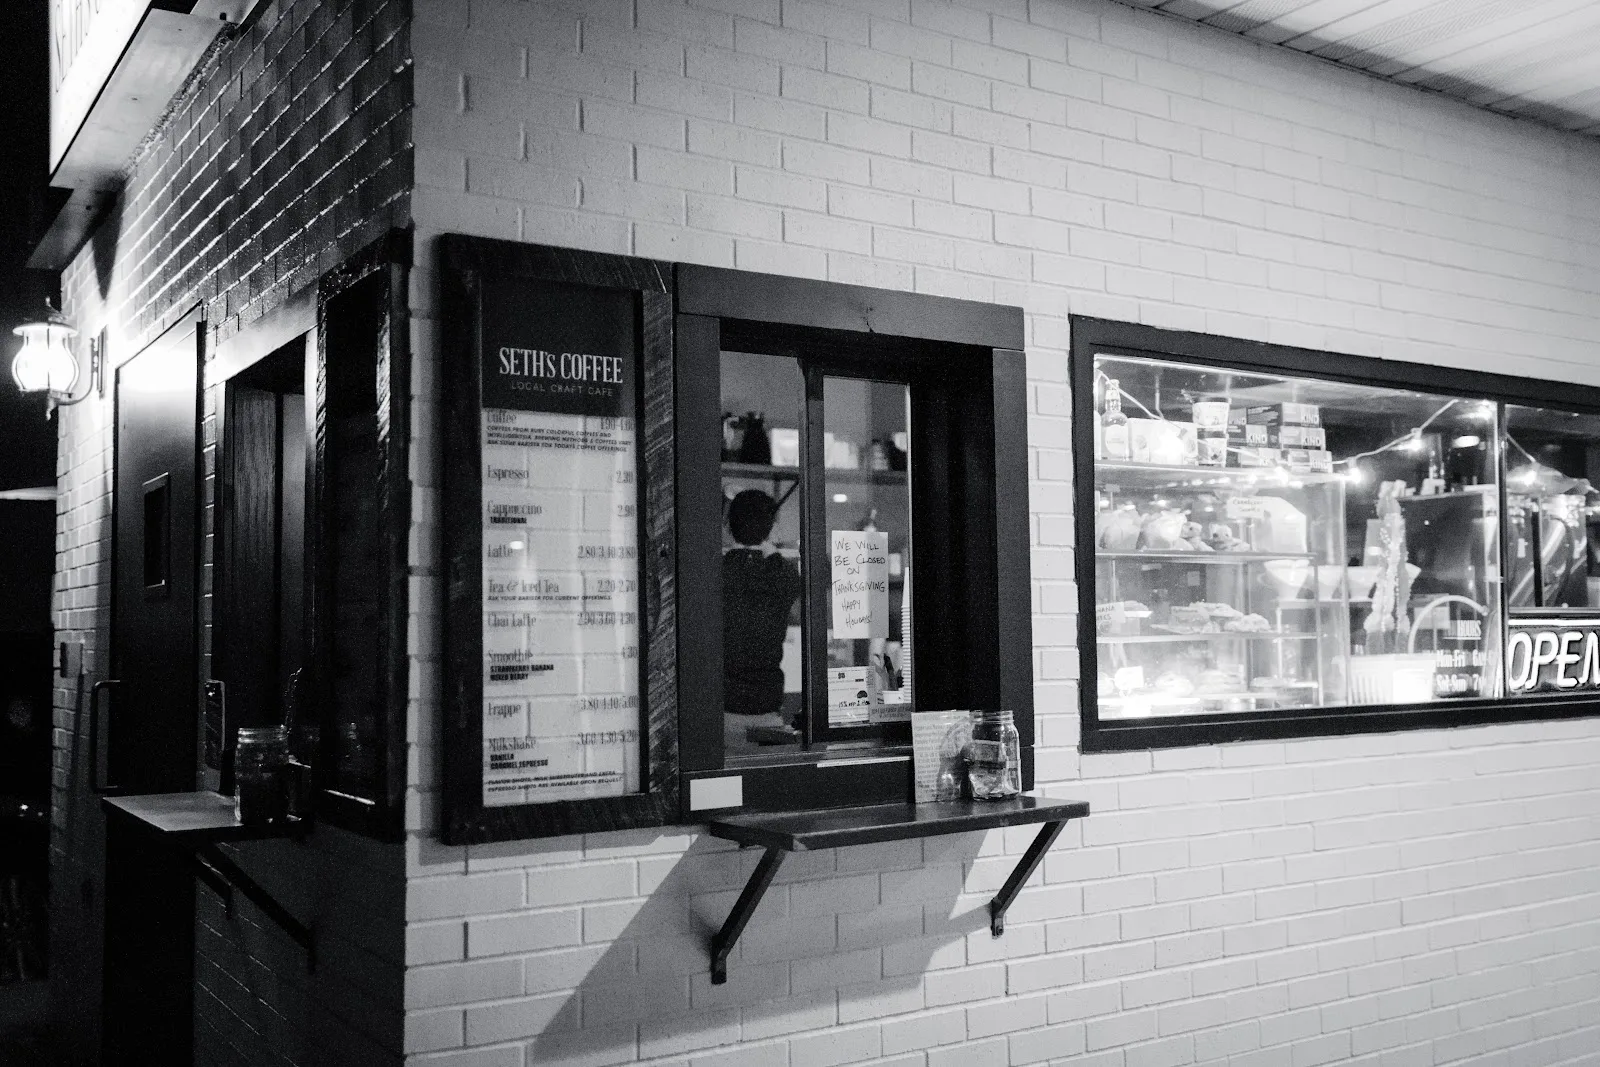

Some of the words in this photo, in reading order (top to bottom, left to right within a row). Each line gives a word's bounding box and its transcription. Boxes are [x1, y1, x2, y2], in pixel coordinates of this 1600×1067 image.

[560, 352, 623, 384] COFFEE
[511, 381, 545, 392] LOCAL
[551, 383, 582, 394] CRAFT
[488, 465, 530, 480] Espresso
[488, 500, 542, 517] Cappuccino
[488, 544, 514, 558] Latte
[835, 538, 851, 551] WE
[856, 540, 880, 551] WILL
[834, 556, 850, 566] BE
[856, 554, 886, 564] CLOSED
[846, 566, 860, 575] ON
[488, 579, 504, 592] Tea
[522, 580, 541, 592] Iced
[544, 579, 560, 592] Tea
[832, 579, 886, 596] THANKSGIVING
[842, 598, 860, 612] HAPPY
[488, 612, 509, 627] Chai
[512, 613, 536, 628] Latte
[488, 702, 522, 718] Frappe
[489, 736, 536, 752] Milkshake
